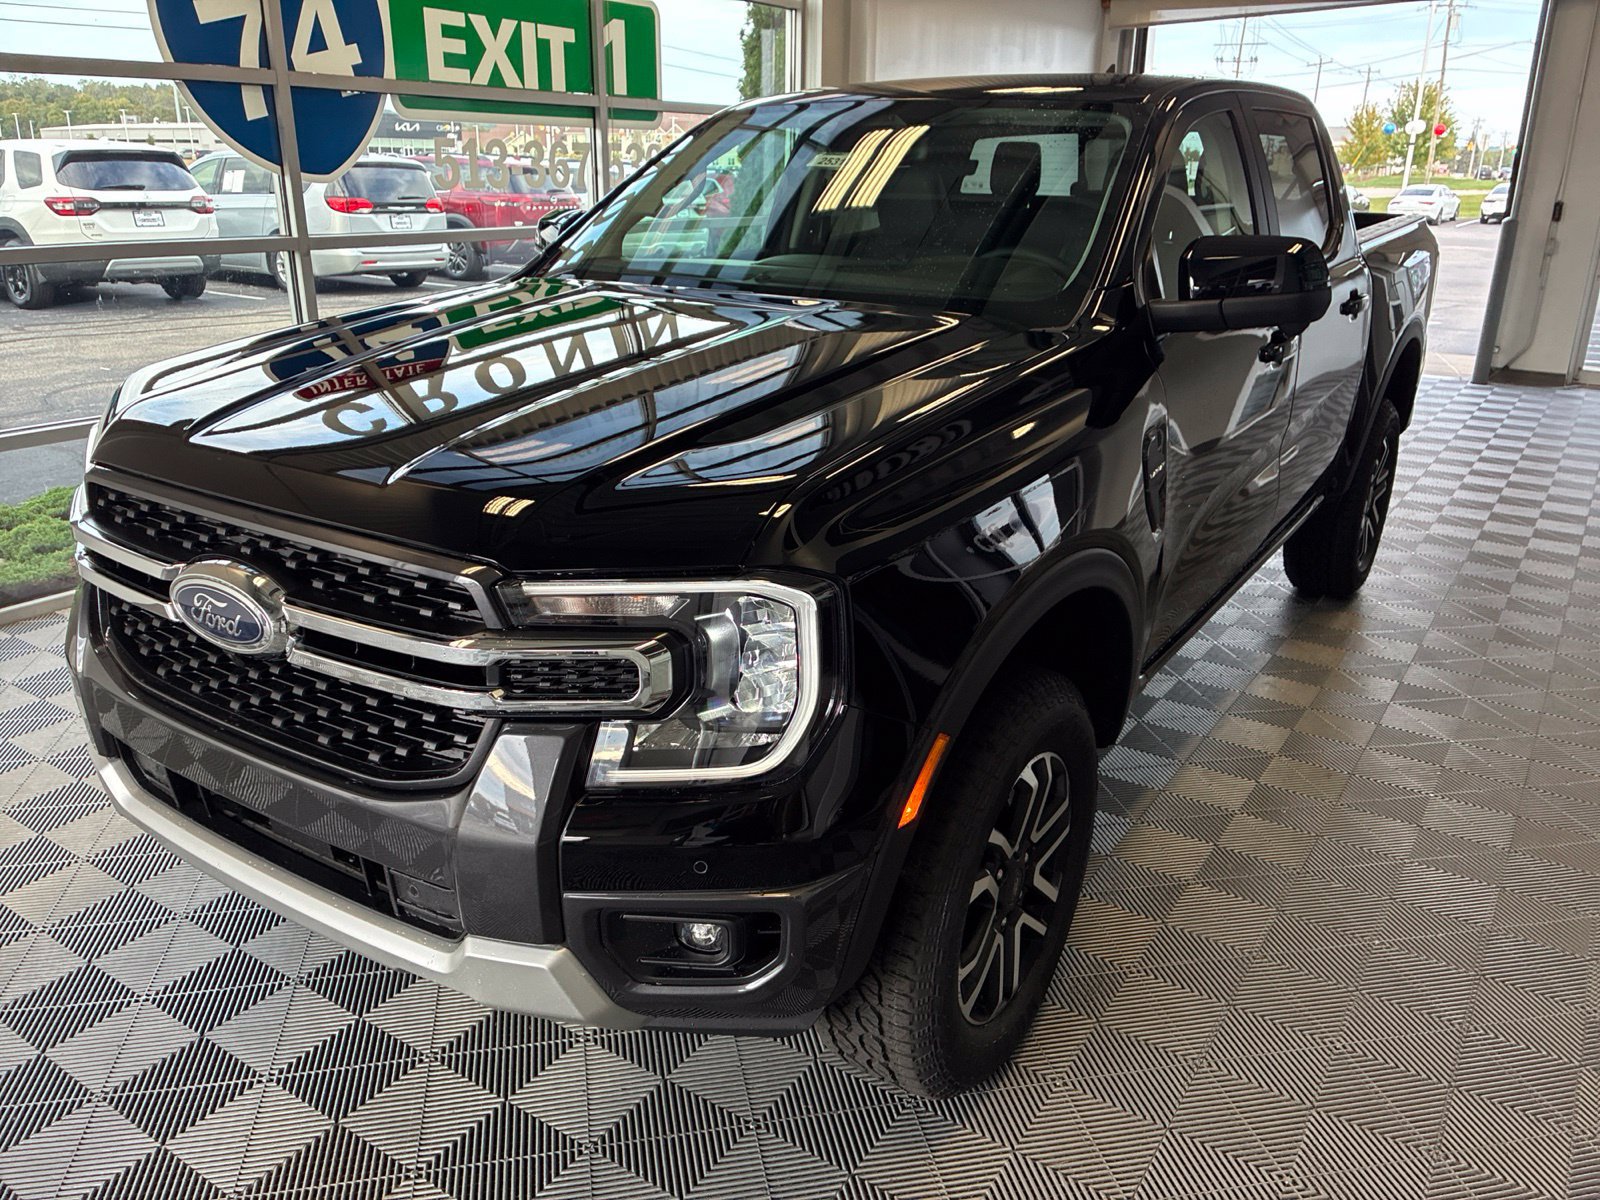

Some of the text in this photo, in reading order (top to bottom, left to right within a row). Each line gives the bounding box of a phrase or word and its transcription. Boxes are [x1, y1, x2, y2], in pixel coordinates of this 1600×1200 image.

[199, 0, 362, 121] 74
[423, 6, 628, 96] EXIT 1
[191, 593, 242, 637] Ford
